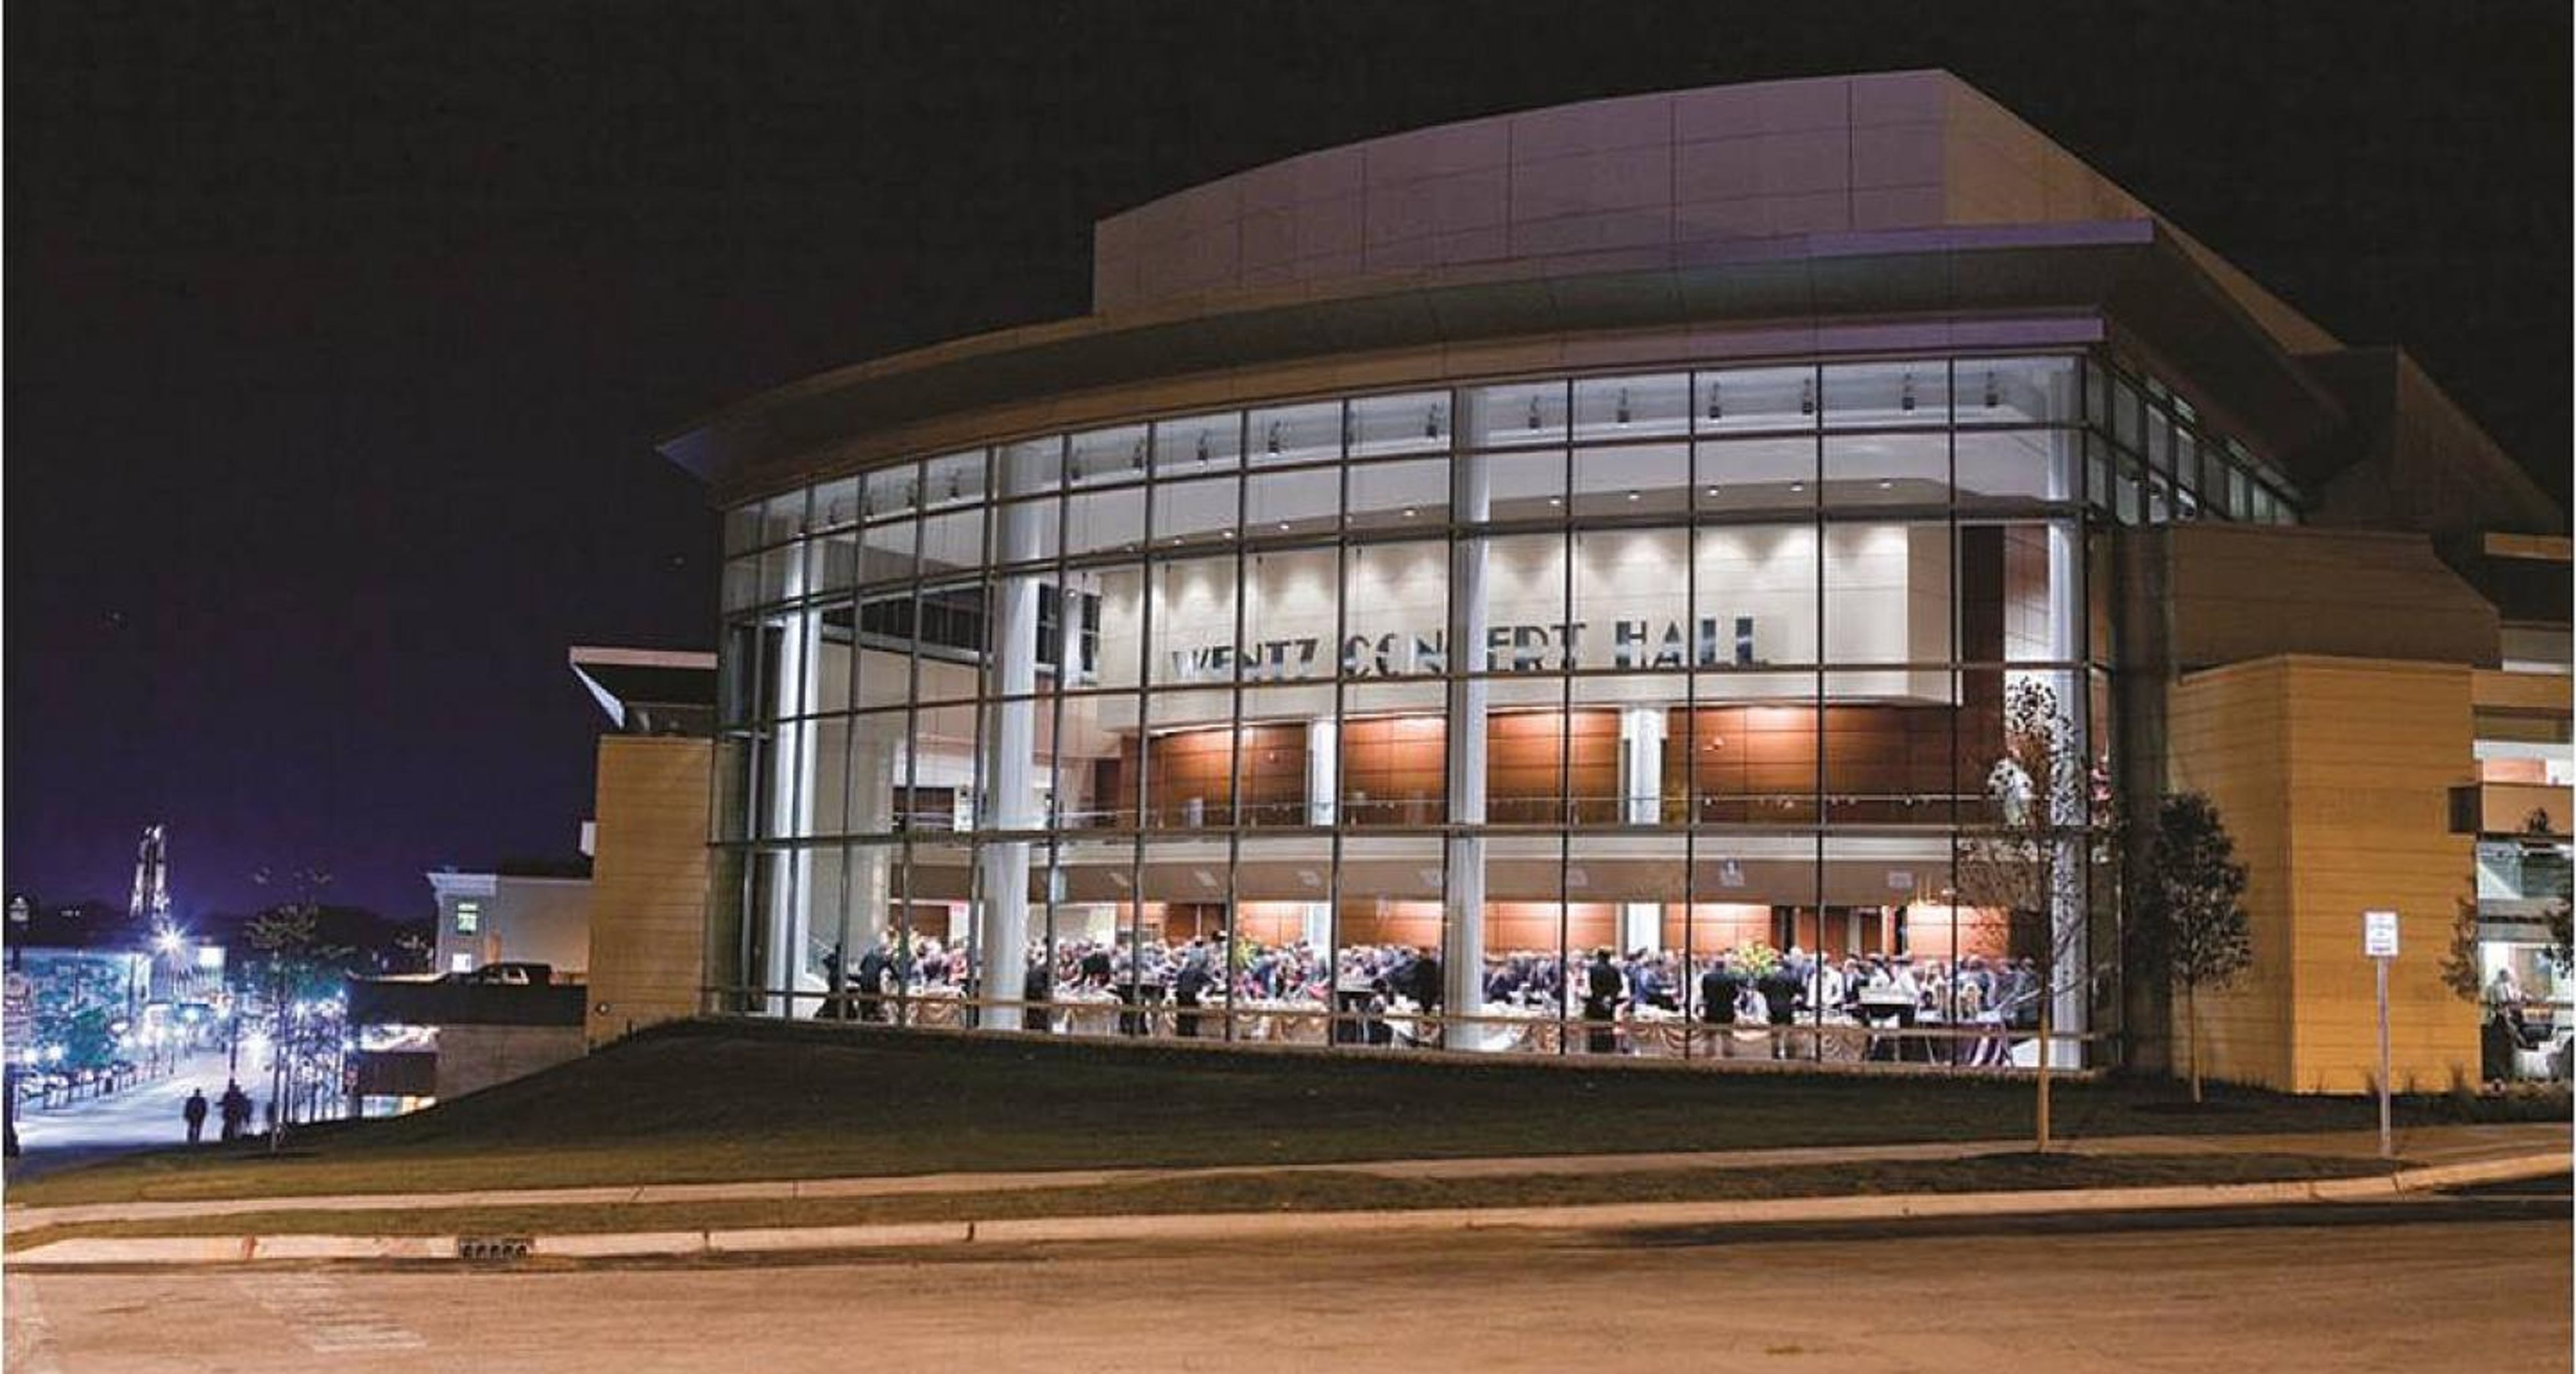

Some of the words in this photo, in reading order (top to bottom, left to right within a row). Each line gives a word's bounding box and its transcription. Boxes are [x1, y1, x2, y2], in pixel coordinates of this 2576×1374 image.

[1172, 638, 1318, 682] WENTZ
[1343, 623, 1587, 678] CONERT
[1615, 617, 1770, 671] HALL
